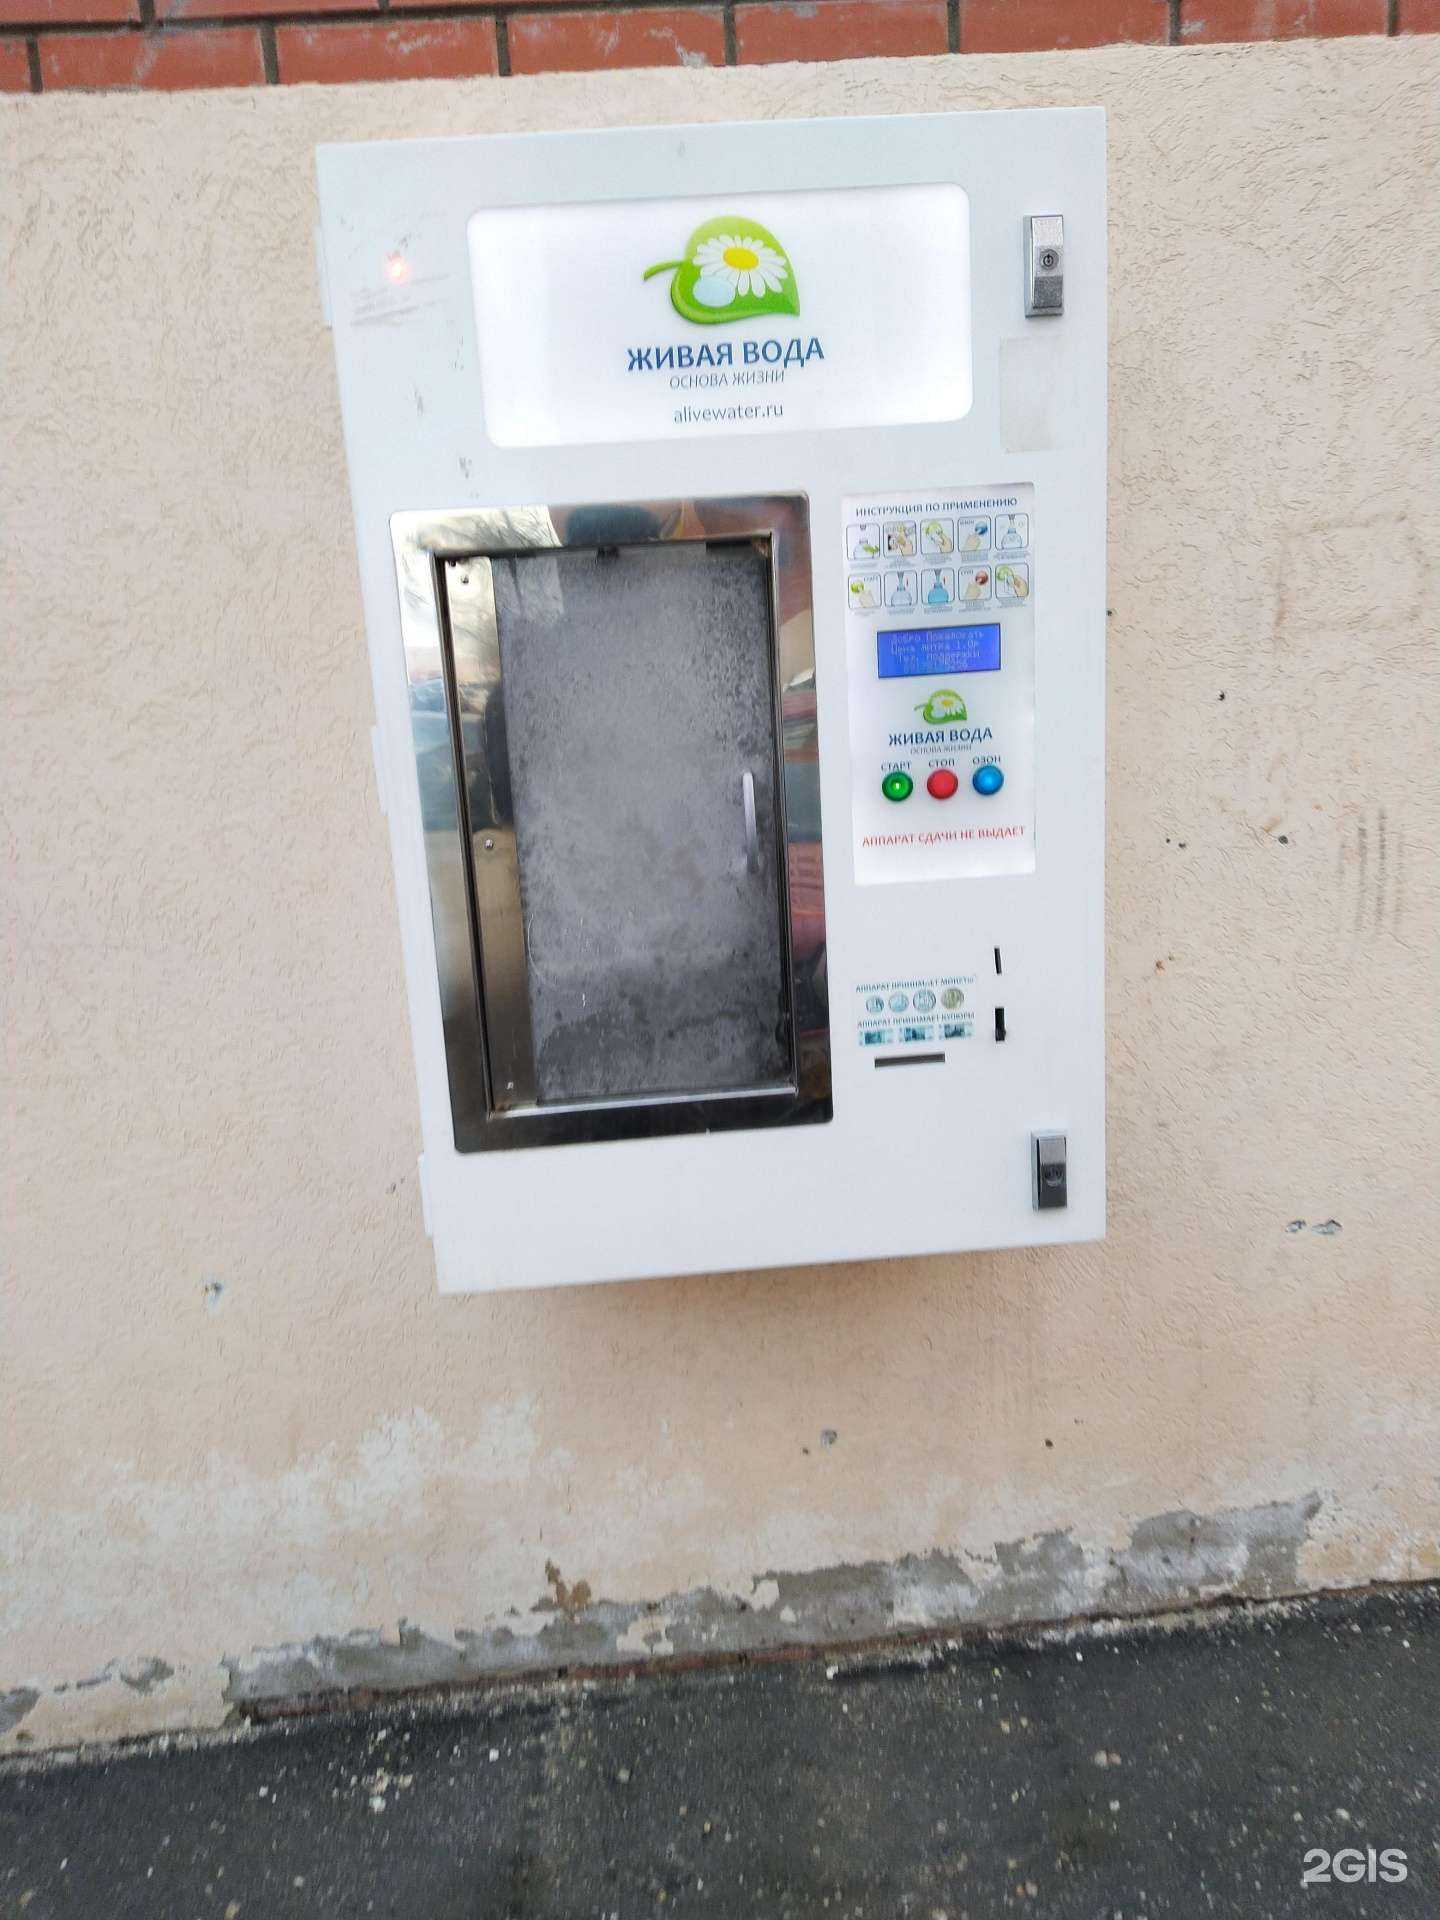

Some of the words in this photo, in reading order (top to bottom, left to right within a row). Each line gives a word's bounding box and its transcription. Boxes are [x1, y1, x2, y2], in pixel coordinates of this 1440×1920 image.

[627, 343, 733, 371] ЖИВАЯ
[743, 336, 824, 368] ВОДА
[669, 373, 728, 389] ОСНОВА
[732, 370, 785, 386] ЖИЗНИ
[674, 404, 783, 424] alivewater.ru
[856, 502, 922, 517] ИНСТРУКЦИЯ
[925, 501, 940, 512] ПО
[943, 497, 1017, 511] ПРИМЕНЕНИЮ
[889, 731, 944, 747] ЖИВАЯ
[949, 727, 993, 743] ВОДА
[881, 761, 912, 772] СТАРТ
[928, 758, 955, 768] СТОП
[972, 755, 1002, 765] ОЗОН
[862, 833, 915, 848] АППАРАТ
[918, 830, 957, 845] СДАЧИ
[960, 829, 975, 840] НЕ
[978, 825, 1026, 840] ВЫДАЕТ
